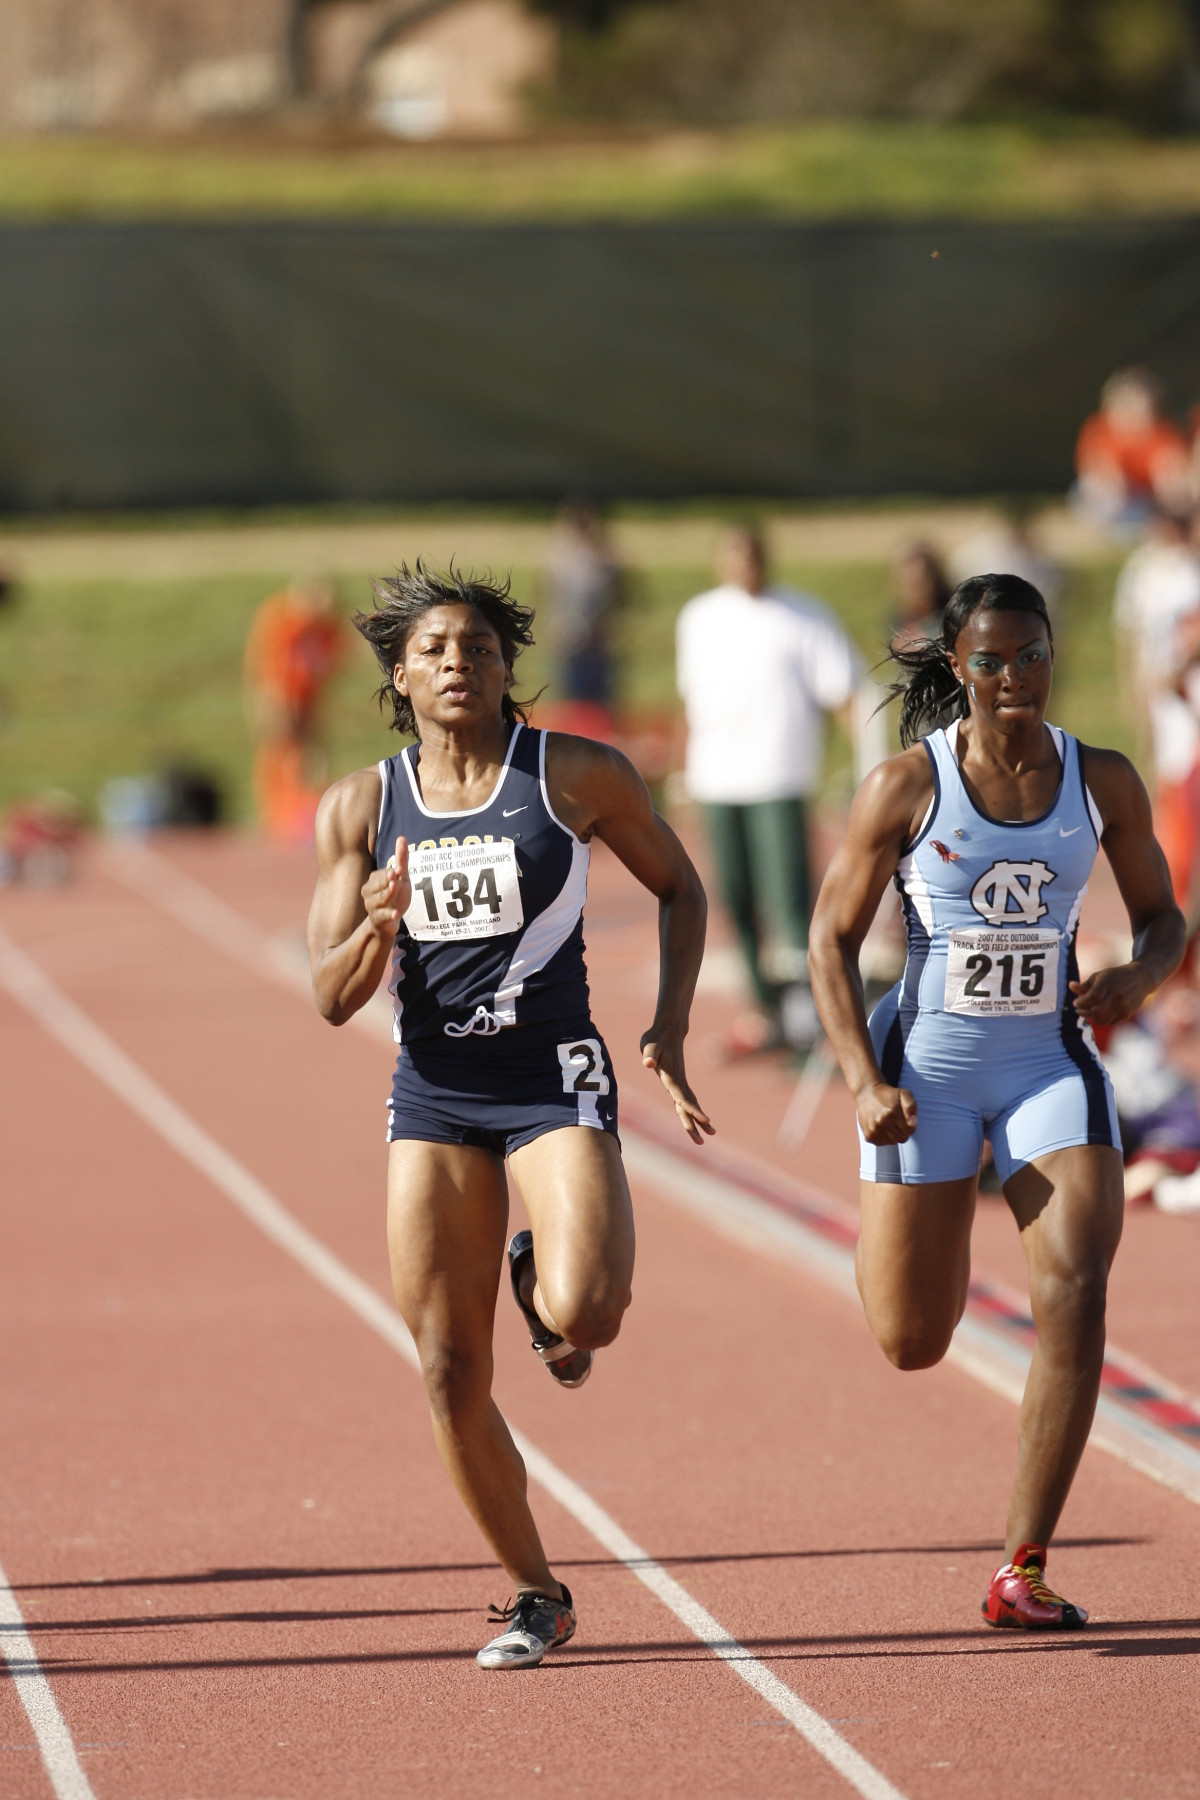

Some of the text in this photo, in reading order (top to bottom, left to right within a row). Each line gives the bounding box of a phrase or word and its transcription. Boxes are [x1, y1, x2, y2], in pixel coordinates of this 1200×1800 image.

[421, 847, 485, 863] 2007 ACC OUTDOOR
[420, 863, 434, 874] AND
[436, 860, 454, 871] FIELD
[456, 853, 512, 869] CHAMPIONSHIPS
[414, 867, 503, 922] 134
[426, 922, 451, 930] COLLEGE
[469, 916, 501, 926] MARYLAND
[953, 940, 975, 950] TRACK
[991, 943, 1009, 951] FIELD
[978, 933, 1040, 943] 2007 ACC OUTDOOR
[963, 952, 1046, 998] 215
[1011, 998, 1040, 1006] MARYLAND
[568, 1043, 601, 1092] 2
